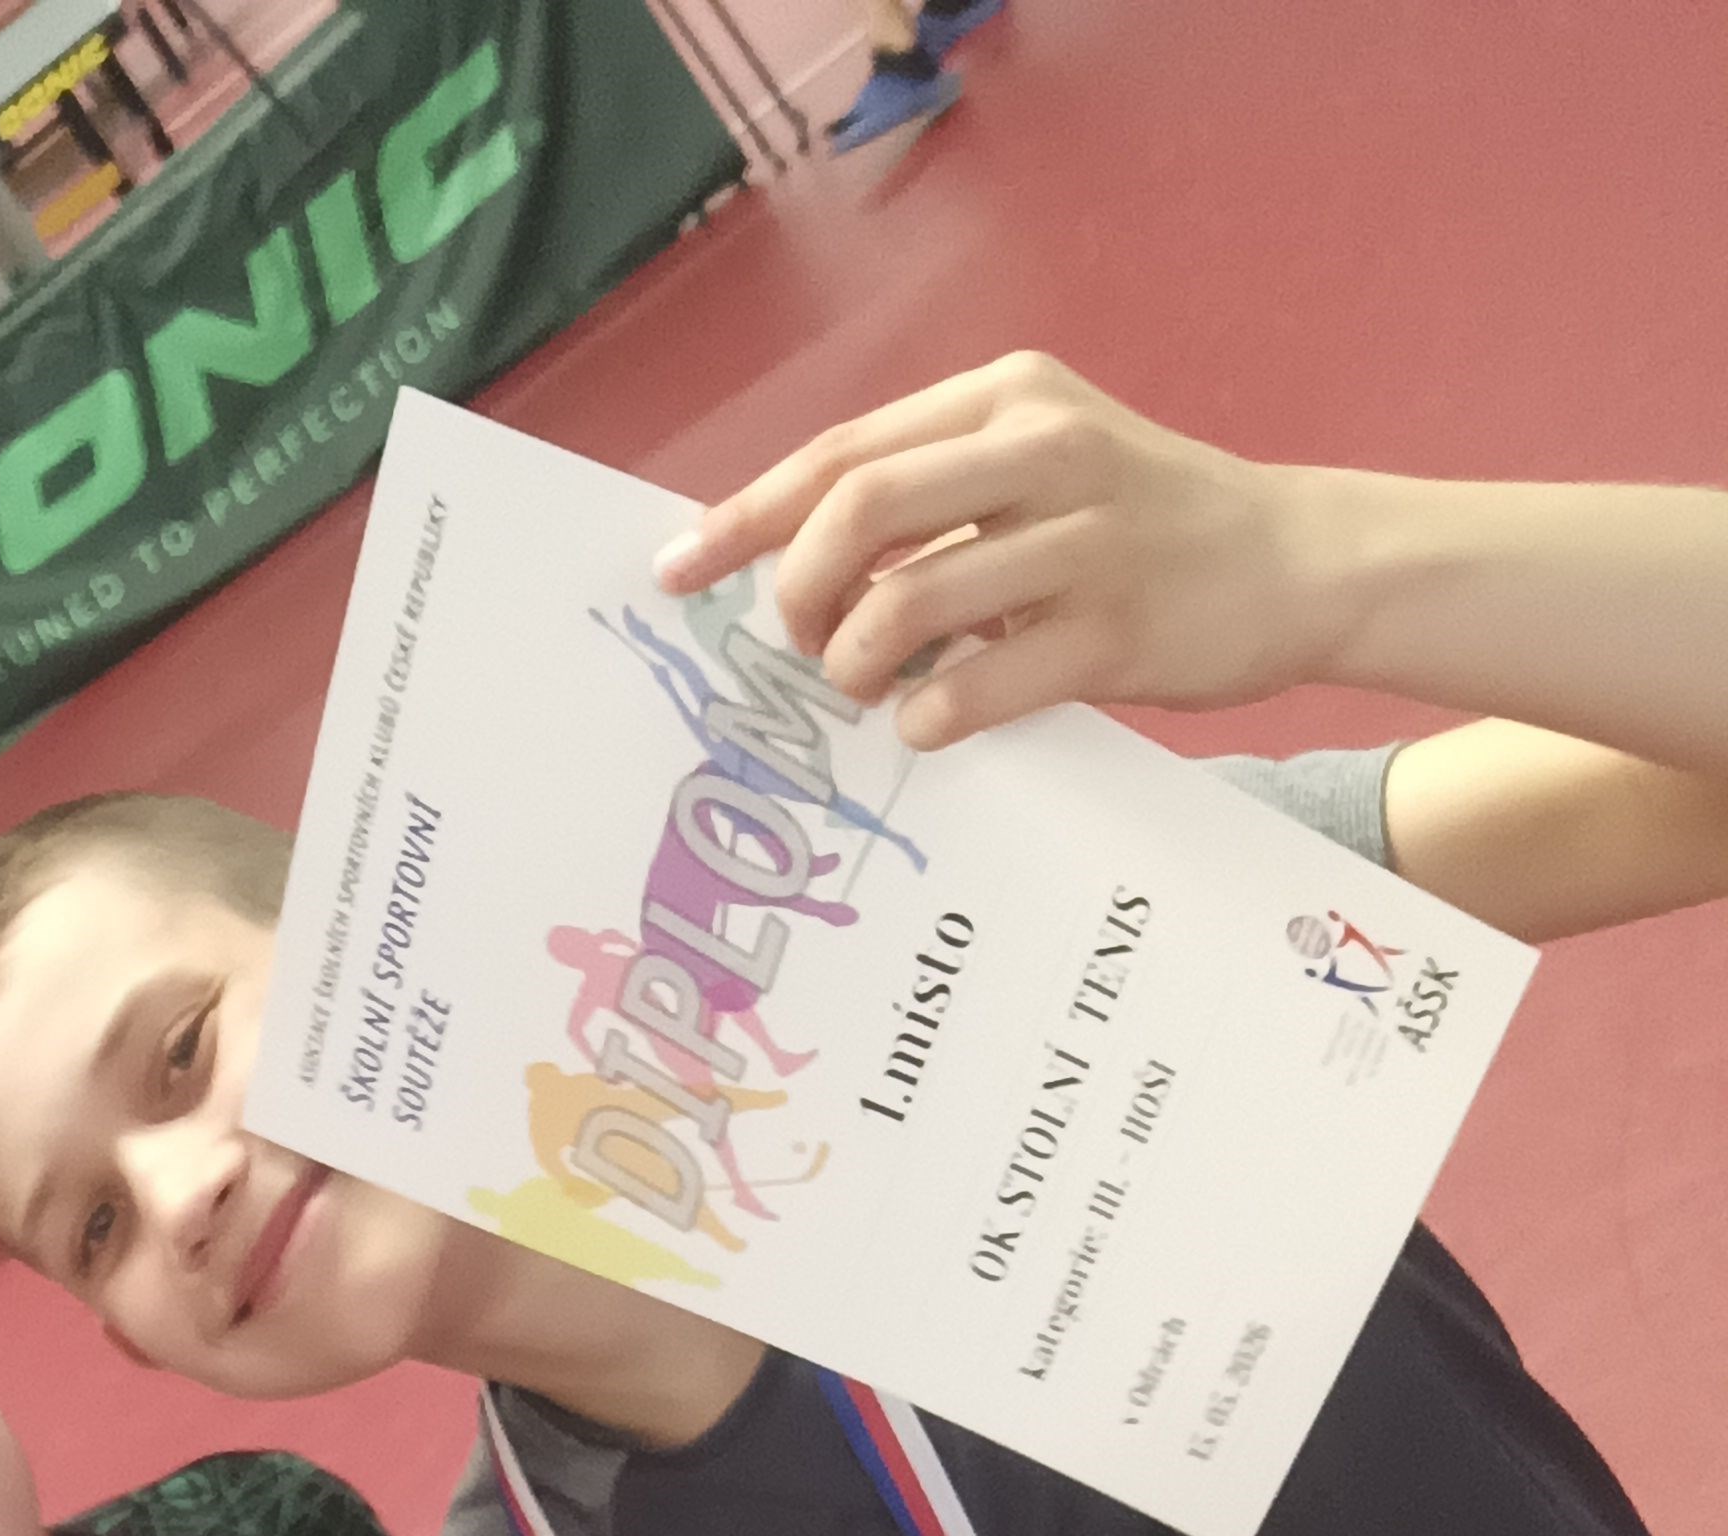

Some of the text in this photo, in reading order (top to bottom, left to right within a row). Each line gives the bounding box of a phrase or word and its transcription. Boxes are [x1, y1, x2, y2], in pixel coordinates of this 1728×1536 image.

[131, 519, 196, 575] TO
[202, 299, 462, 527] PERFECTION
[337, 772, 383, 908] SPORTOVNÍCH
[340, 791, 442, 1112] ŠKOLNÍ SPORTOVNÍ
[571, 621, 864, 1233] DIPLOM
[1069, 884, 1152, 1023] TENIS
[393, 988, 453, 1132] SOUTĚŽE
[1395, 956, 1460, 1054] AŠSK
[1120, 1058, 1176, 1144] HOŠI
